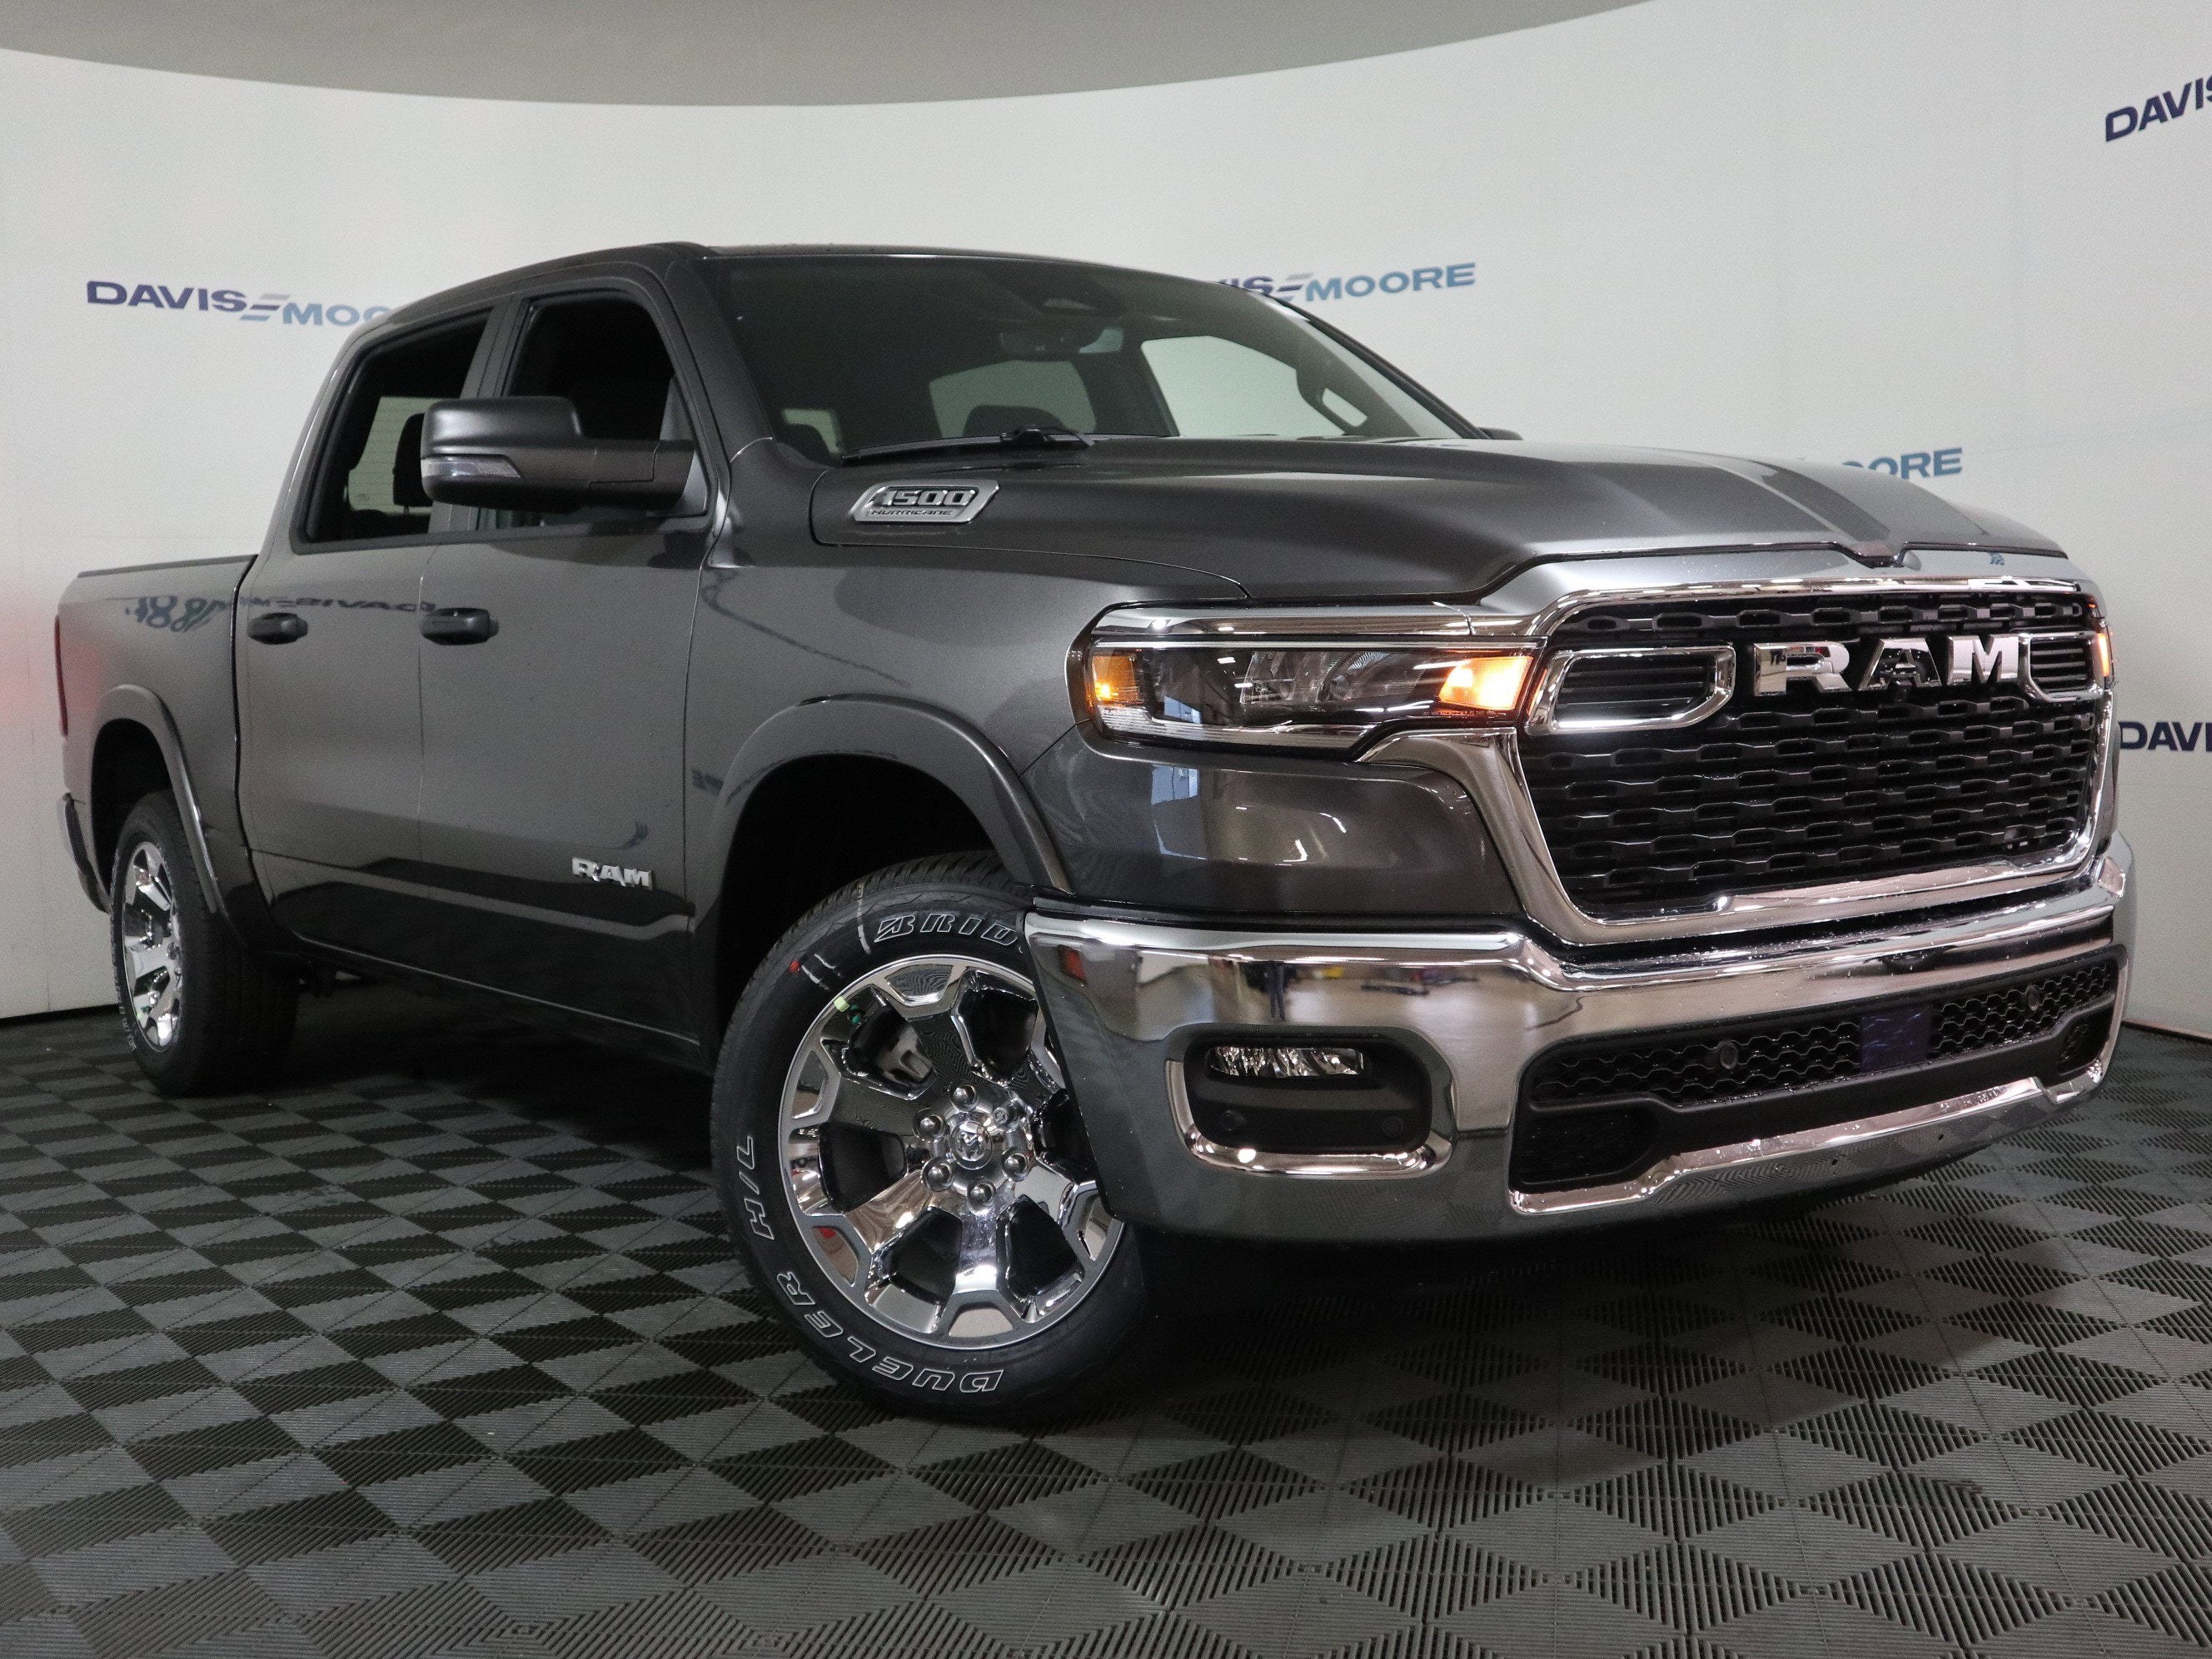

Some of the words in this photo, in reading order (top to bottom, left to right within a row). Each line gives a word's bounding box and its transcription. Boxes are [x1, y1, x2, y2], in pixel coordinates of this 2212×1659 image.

[87, 281, 247, 312] DAVIS
[1306, 262, 1476, 301] MOORE
[1842, 447, 1963, 480] ORE
[870, 508, 954, 516] HURRICANE
[881, 490, 976, 506] 1500
[1753, 634, 2020, 696] RAM
[572, 857, 652, 889] RAM
[874, 914, 1024, 954] BRID
[776, 1271, 1004, 1393] DUELER
